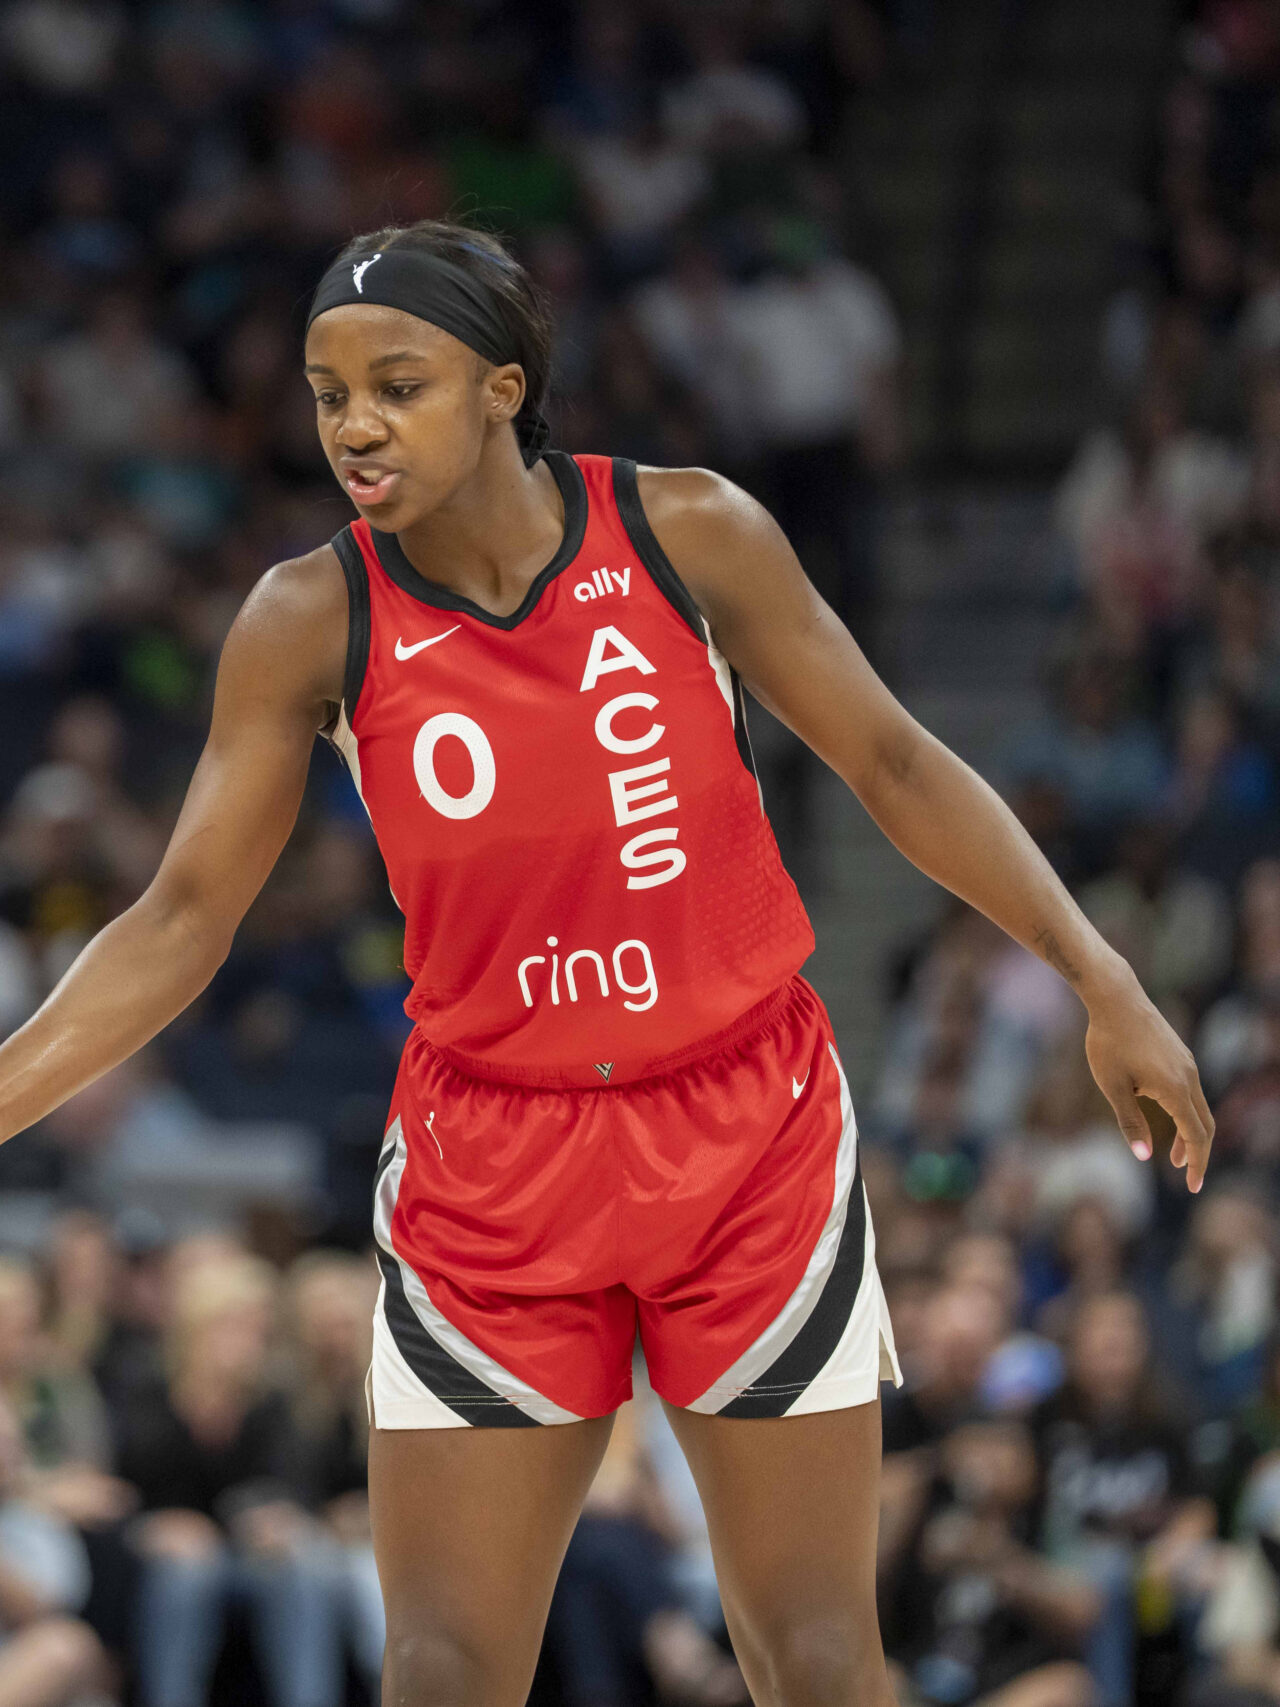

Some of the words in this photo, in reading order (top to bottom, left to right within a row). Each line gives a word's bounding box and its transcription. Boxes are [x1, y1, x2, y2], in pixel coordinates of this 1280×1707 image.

[573, 566, 631, 604] ally
[412, 712, 497, 820] 0
[579, 624, 687, 890] ACES
[517, 935, 659, 1012] ring
